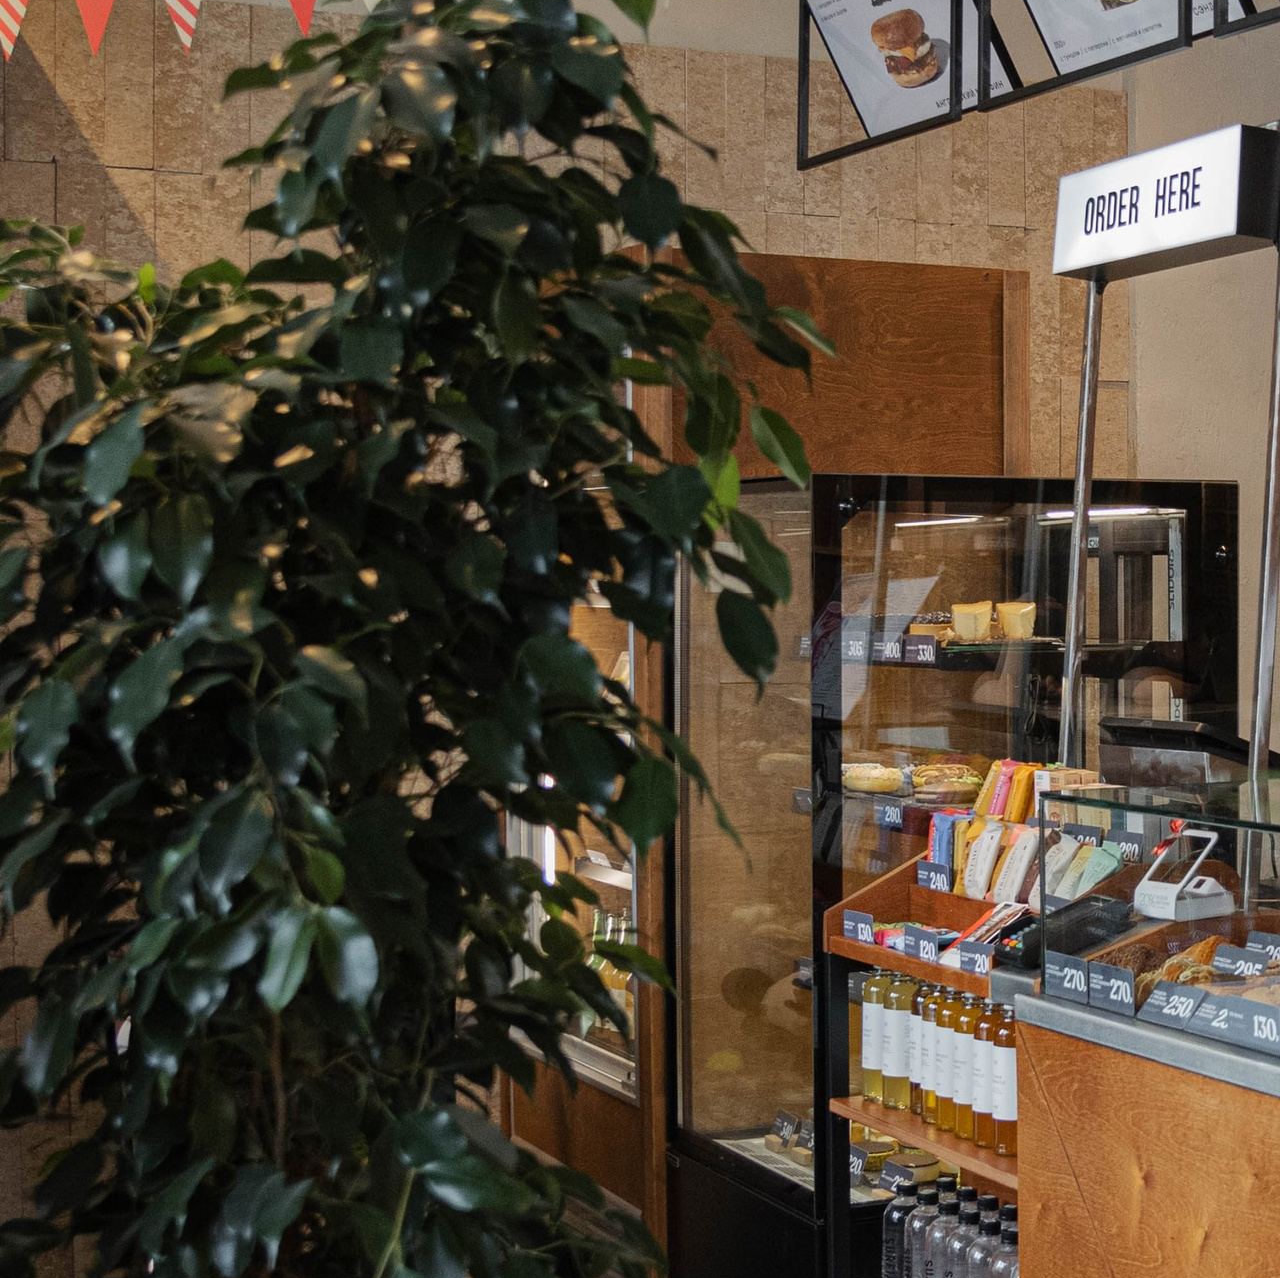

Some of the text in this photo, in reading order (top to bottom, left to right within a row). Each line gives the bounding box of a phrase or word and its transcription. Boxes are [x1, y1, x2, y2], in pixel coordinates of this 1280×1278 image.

[1193, 2, 1215, 16] СЭНД
[1084, 166, 1203, 236] ORDER HERE
